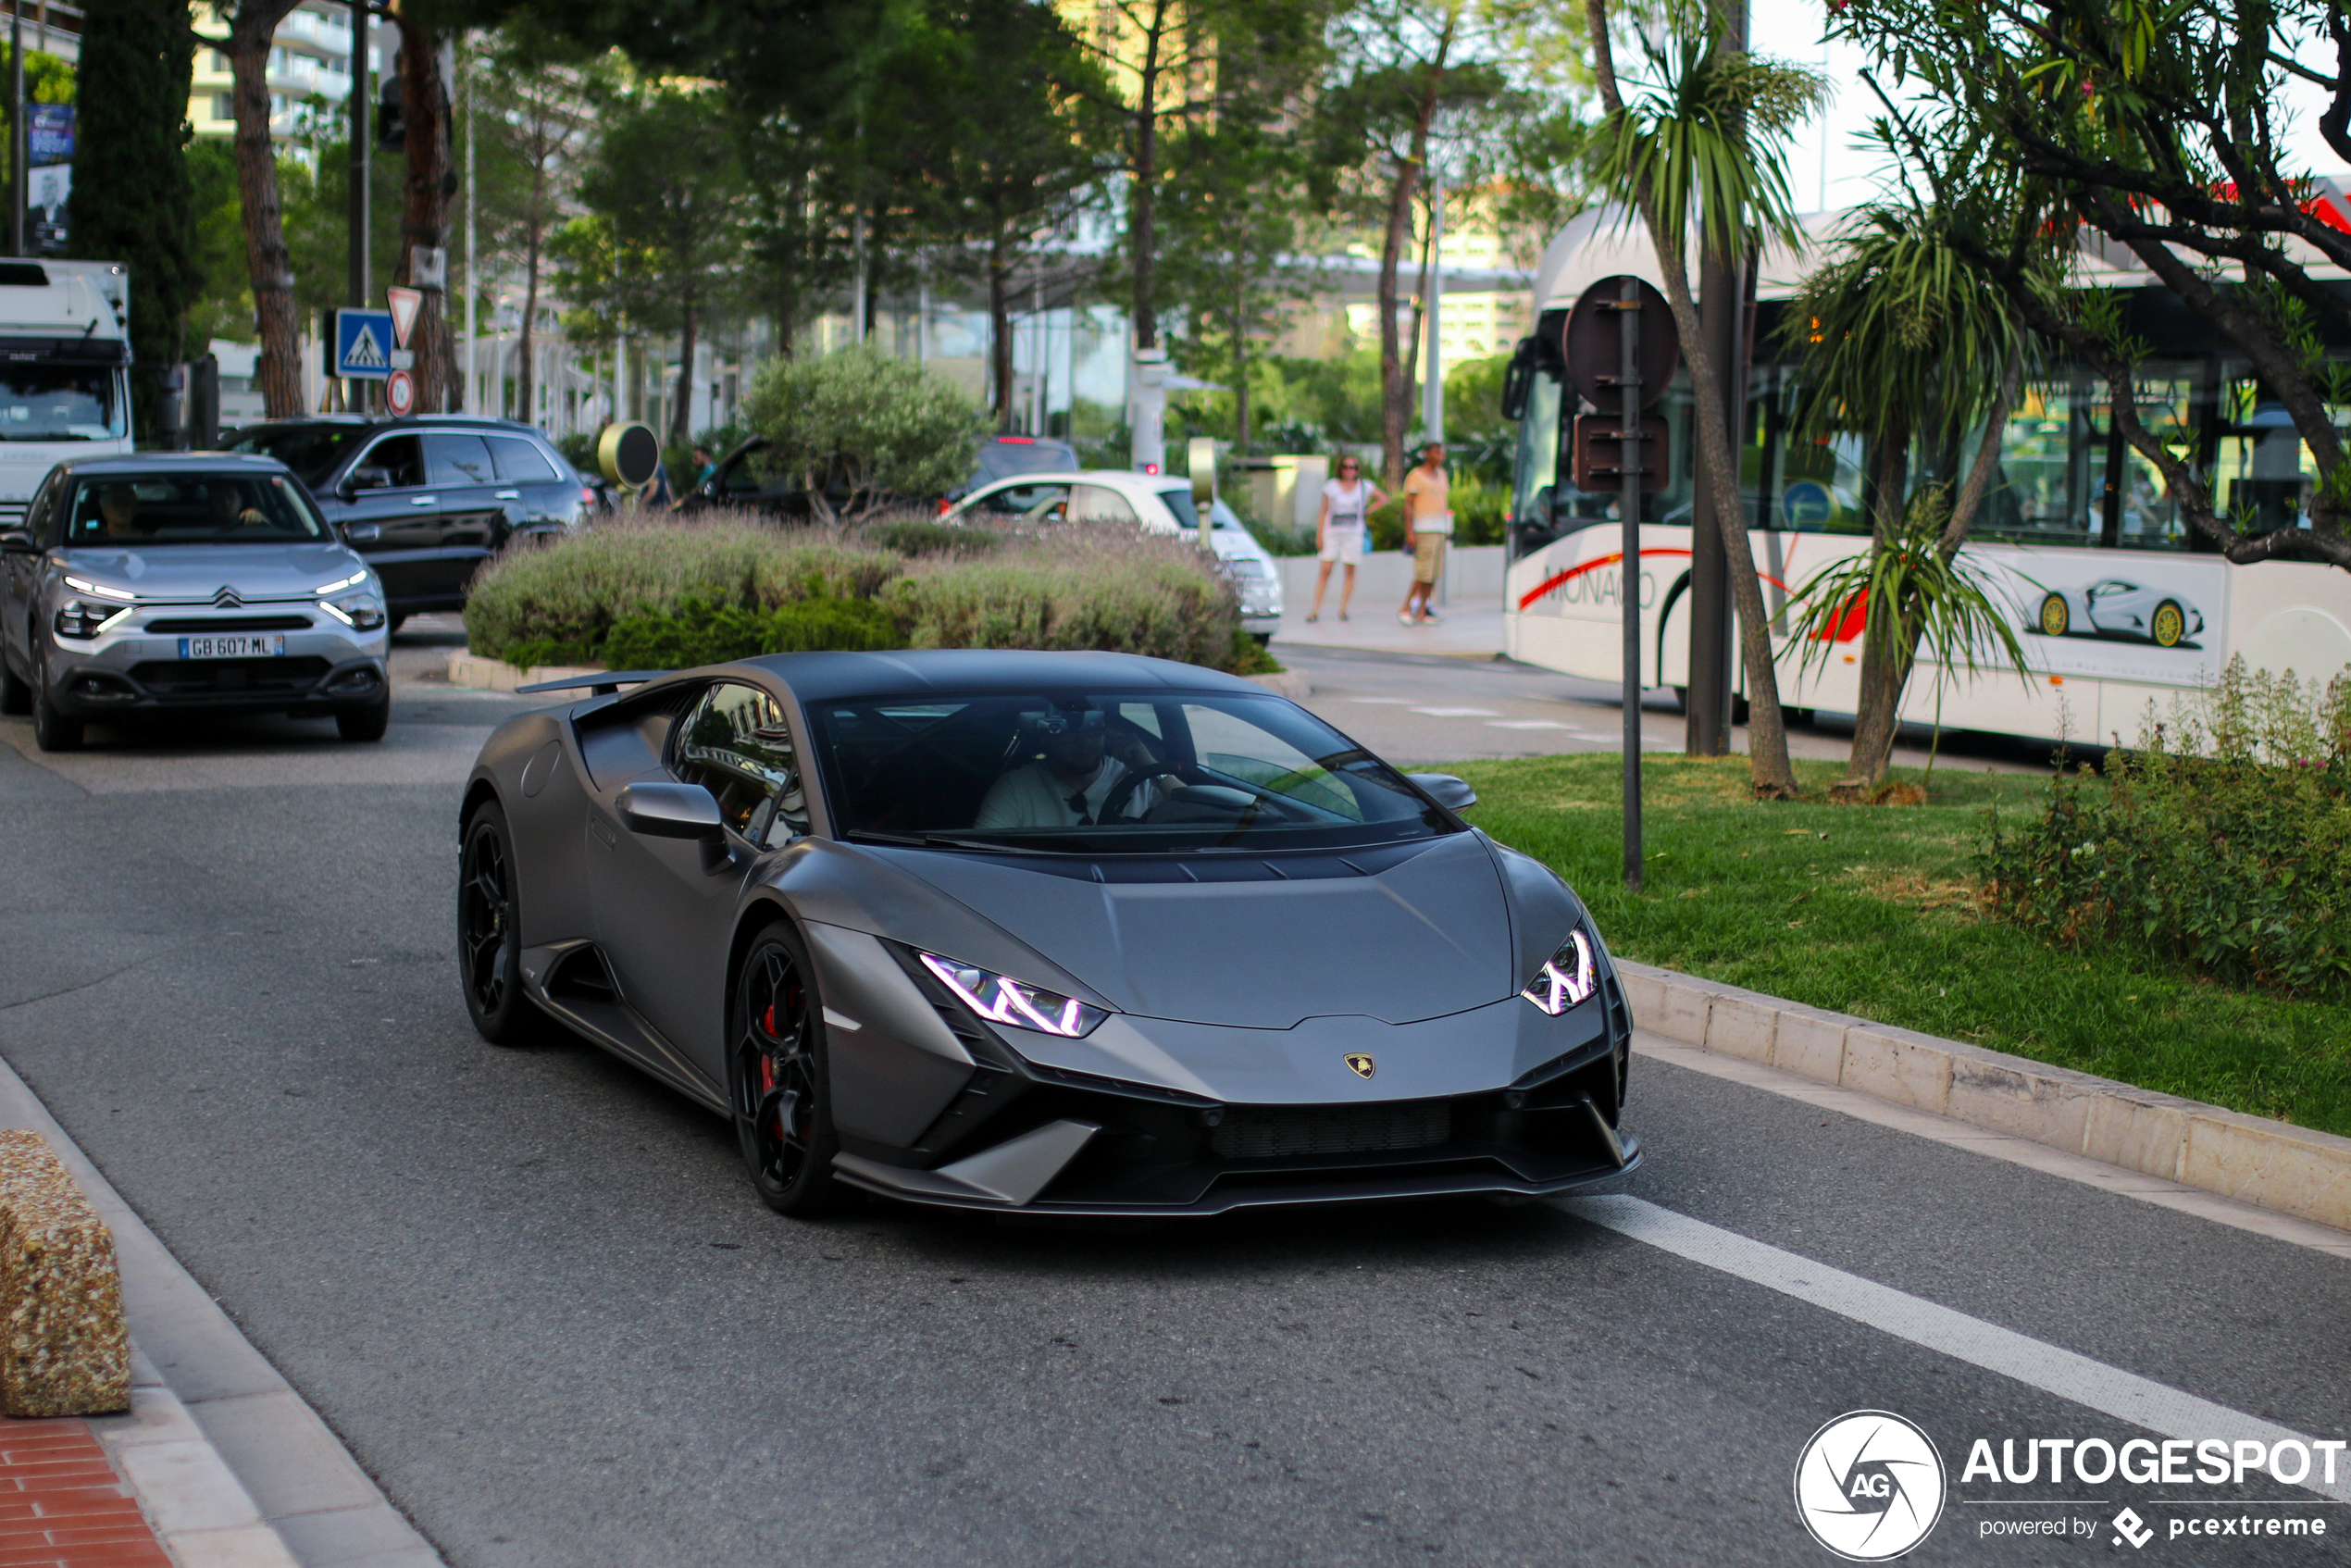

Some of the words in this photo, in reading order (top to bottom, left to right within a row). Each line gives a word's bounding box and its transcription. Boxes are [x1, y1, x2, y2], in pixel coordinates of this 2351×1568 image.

[193, 639, 212, 656] GB
[218, 638, 246, 655] 607
[252, 638, 270, 654] ML
